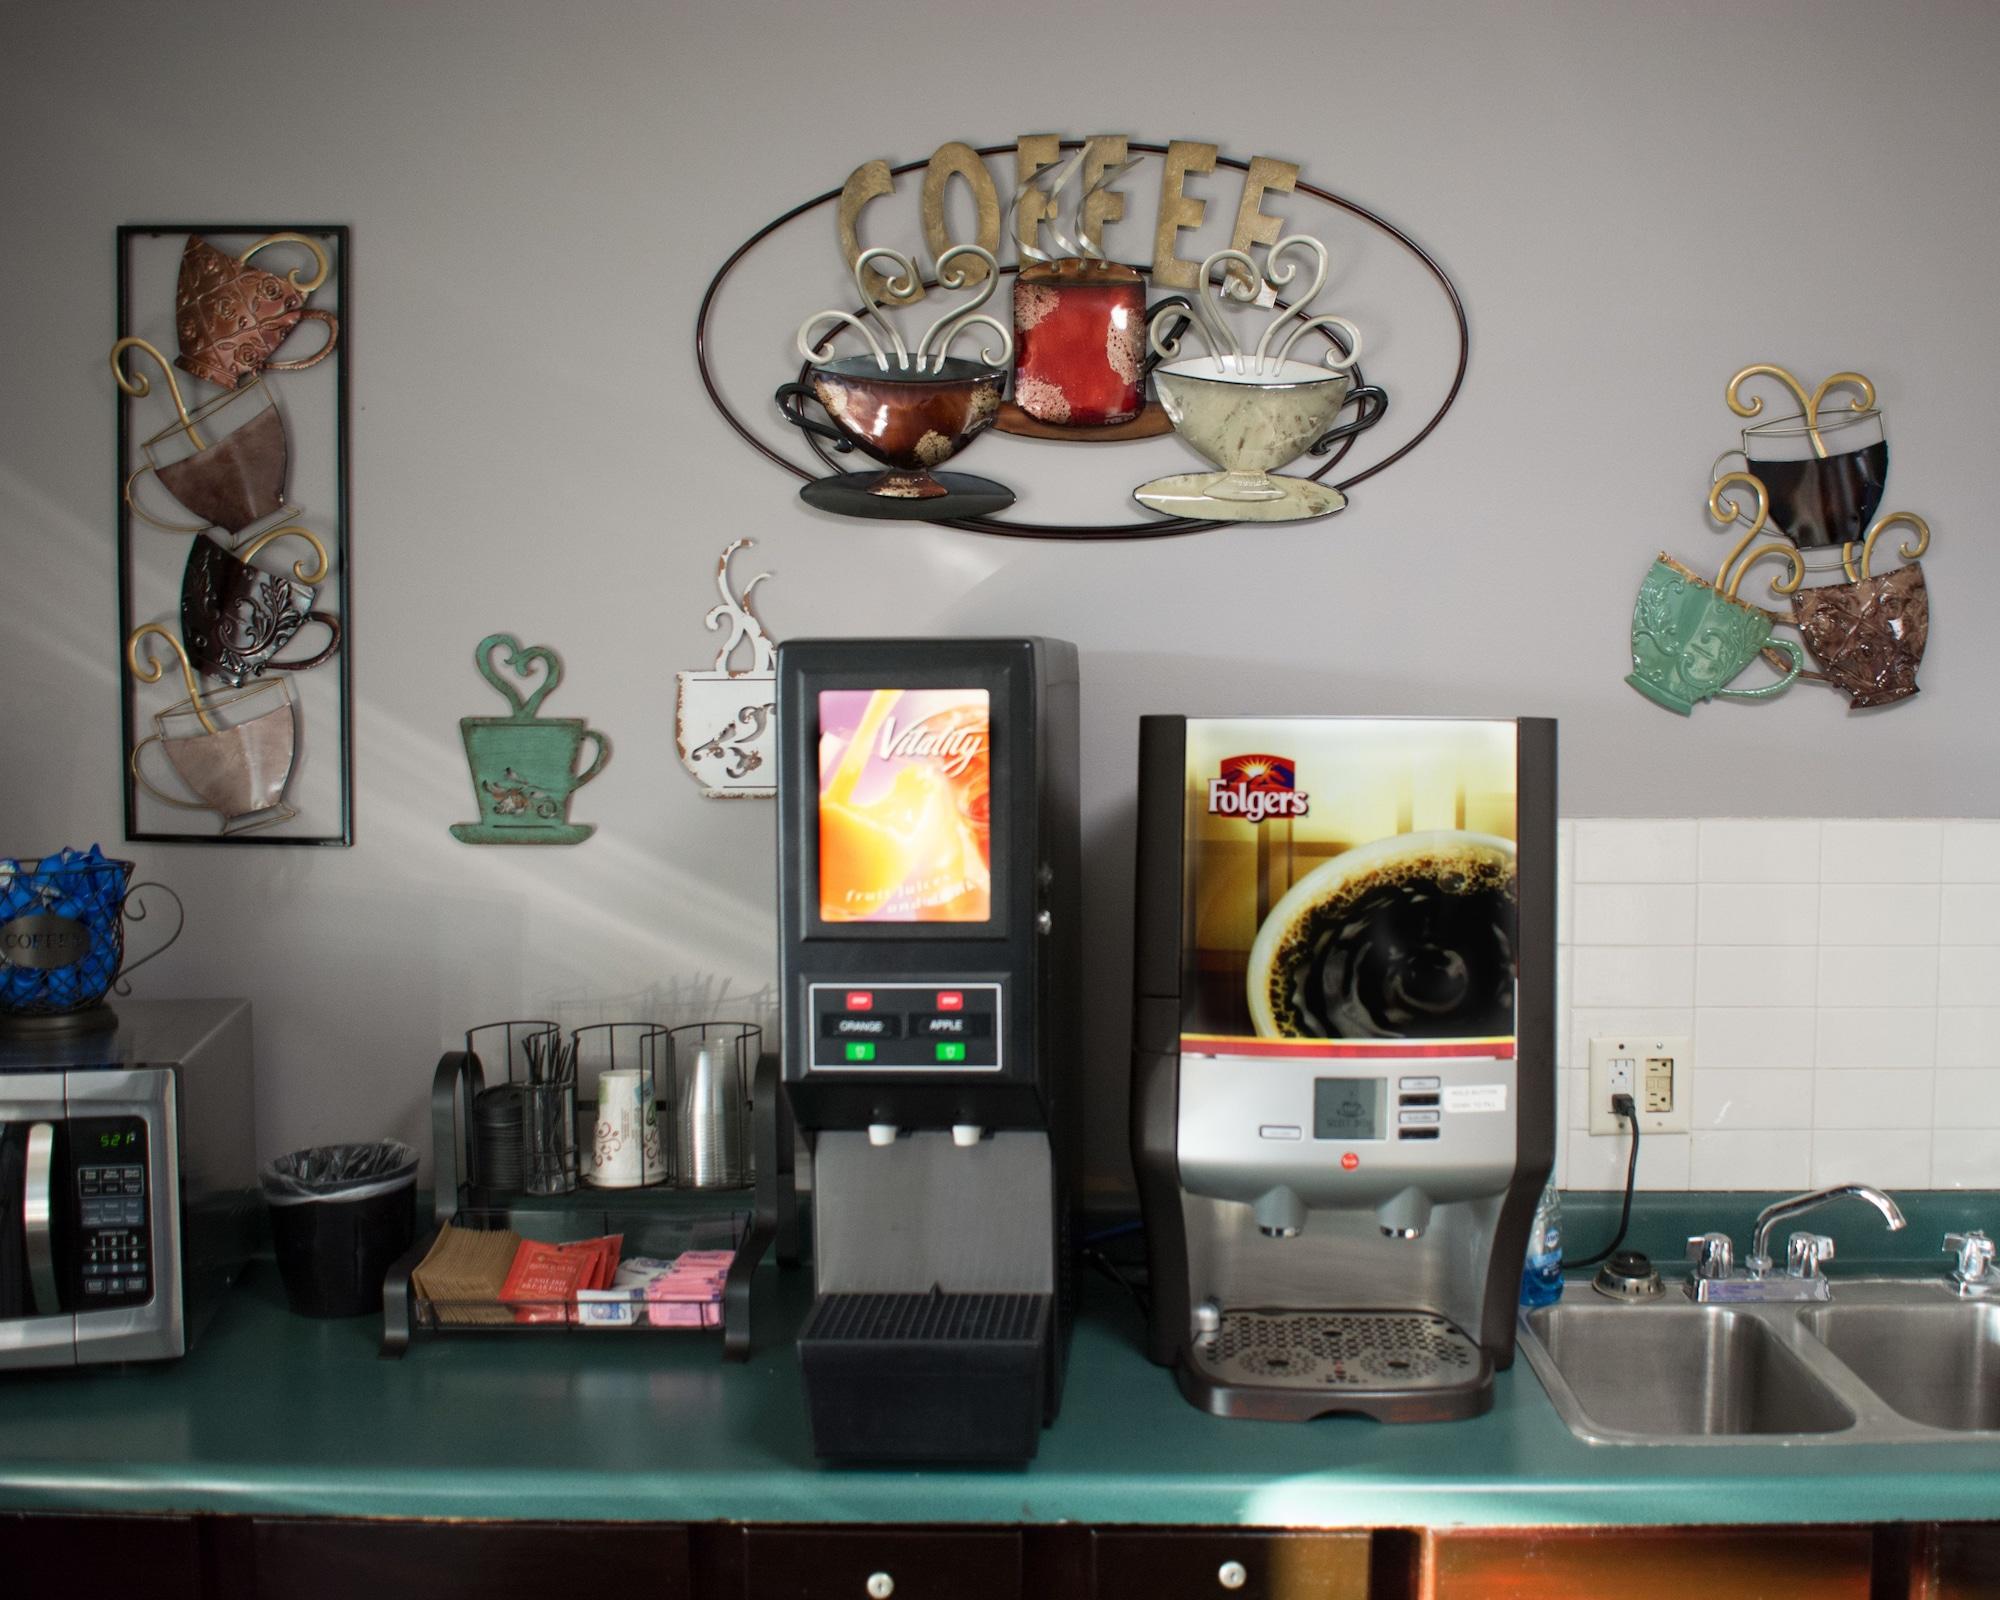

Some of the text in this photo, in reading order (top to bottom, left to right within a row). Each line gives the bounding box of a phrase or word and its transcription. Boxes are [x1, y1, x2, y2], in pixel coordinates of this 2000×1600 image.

[837, 134, 1302, 309] COFFEE
[878, 716, 983, 777] Vitality
[1208, 779, 1309, 823] Folgers
[838, 1019, 884, 1032] ORANGE
[929, 1018, 964, 1032] APPLE
